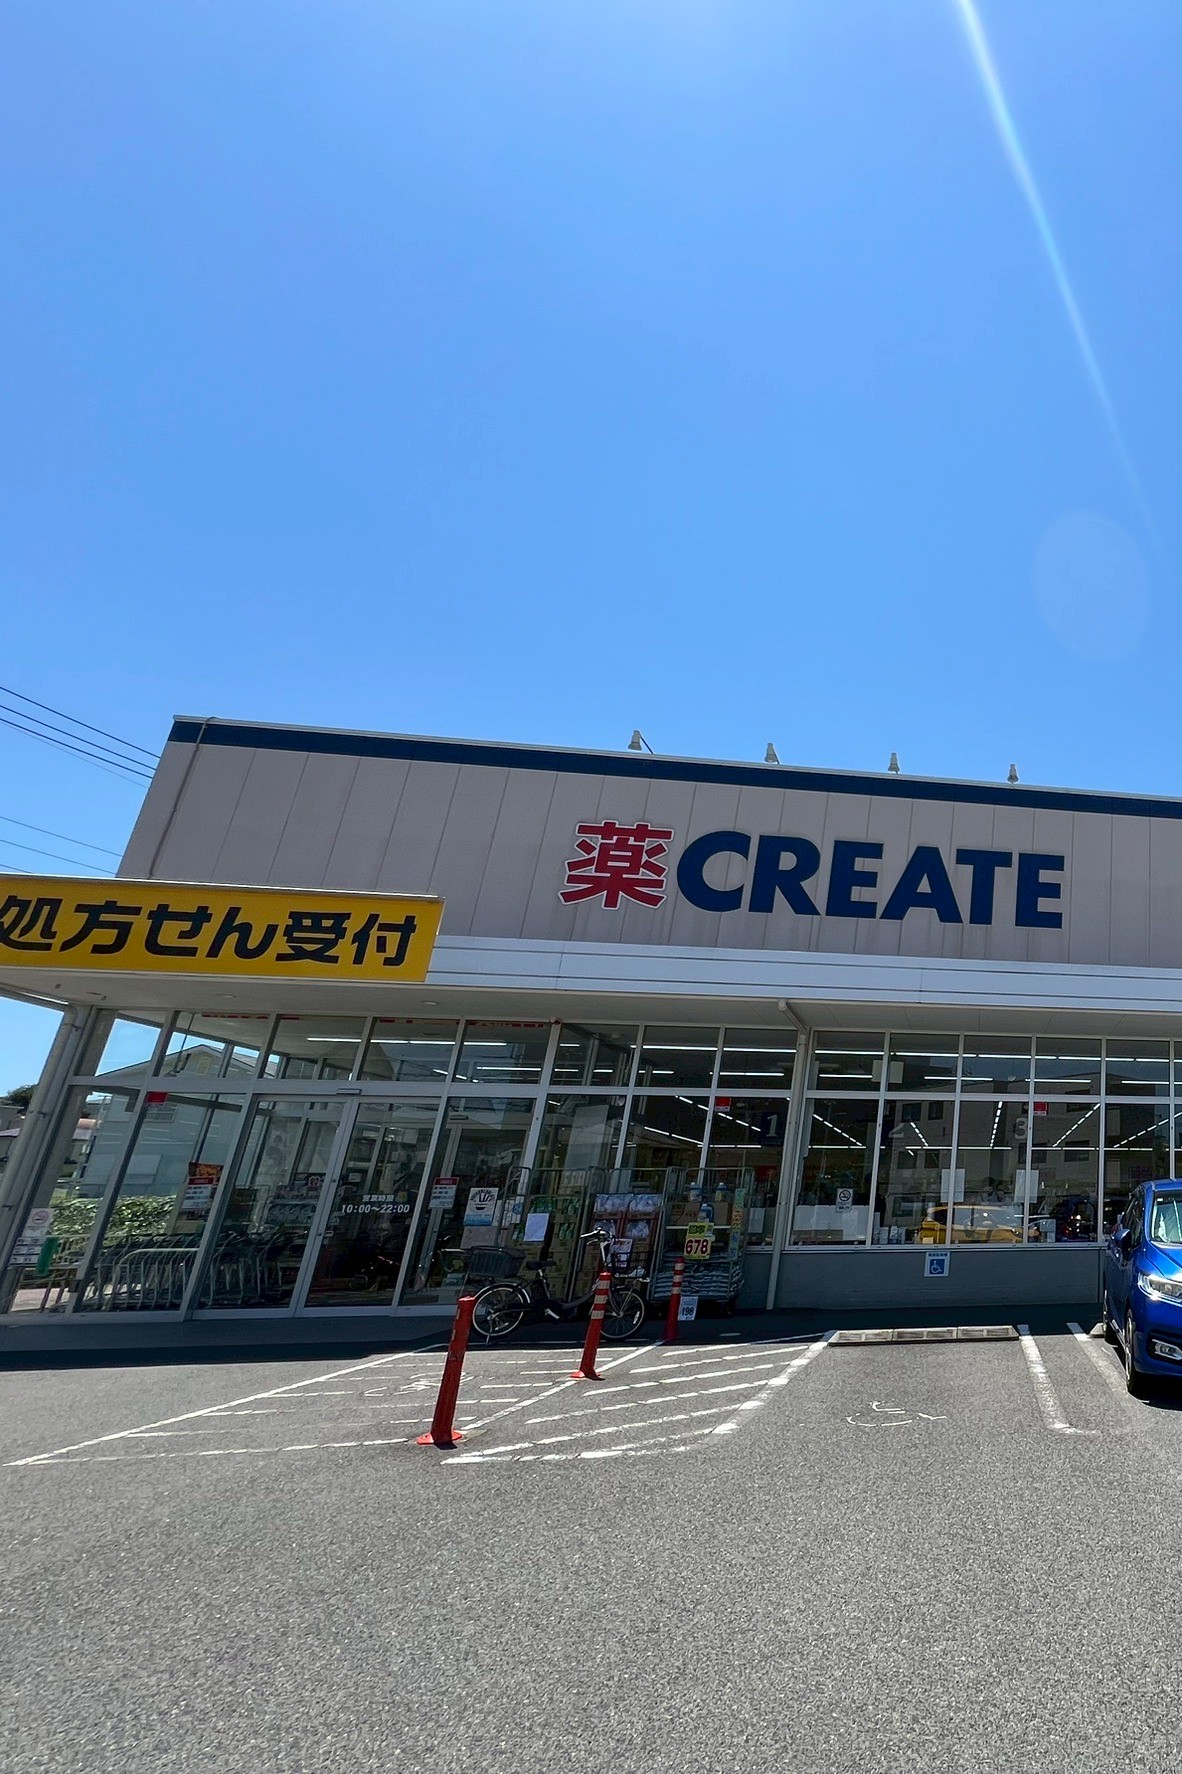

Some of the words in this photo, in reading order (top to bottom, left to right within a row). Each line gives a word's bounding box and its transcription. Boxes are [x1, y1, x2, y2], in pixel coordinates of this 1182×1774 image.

[559, 819, 675, 911] 薬
[677, 830, 1066, 930] CREATE
[0, 894, 418, 967] 処方せん受付
[685, 1238, 709, 1255] 678
